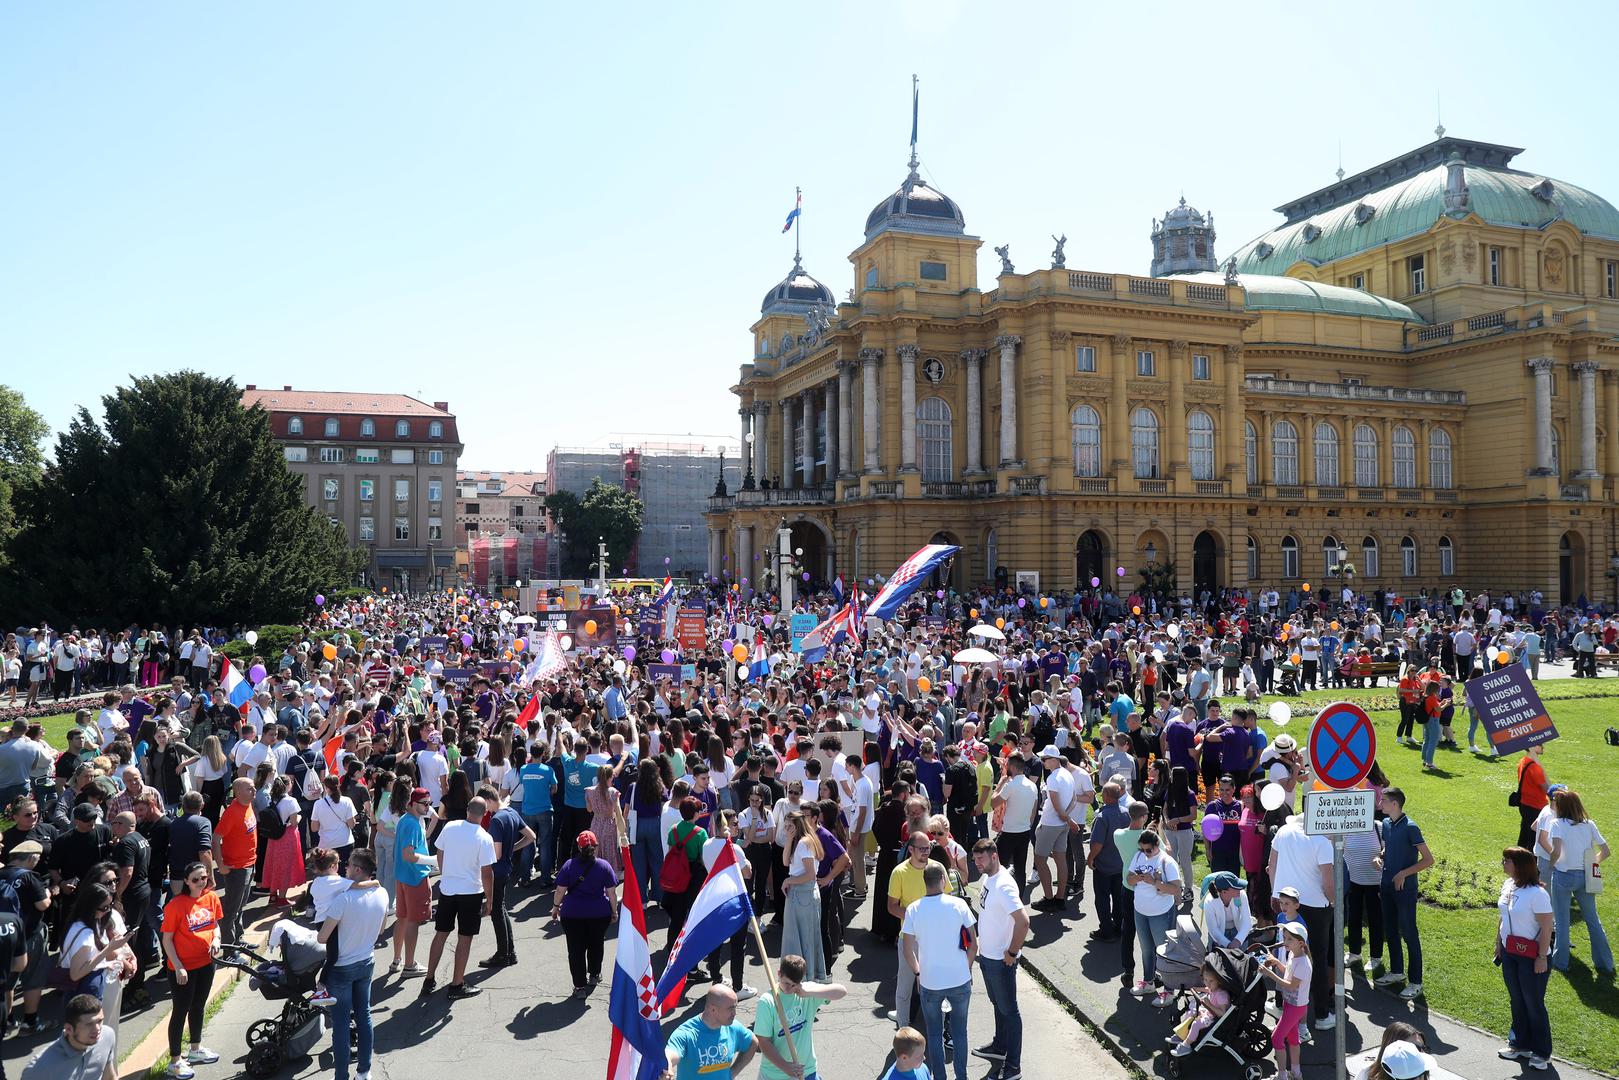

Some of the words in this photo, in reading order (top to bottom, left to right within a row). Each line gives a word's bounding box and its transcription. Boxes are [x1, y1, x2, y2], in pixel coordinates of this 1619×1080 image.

[1482, 674, 1511, 691] SVAKO
[1484, 684, 1522, 704] LJUDSKO
[1490, 702, 1511, 716] BIĆE
[1510, 697, 1529, 710] IMA
[1494, 713, 1523, 729] PRAVO
[1523, 708, 1537, 719] NA
[1507, 723, 1534, 738] ŽIVOT
[1318, 796, 1331, 807] Sva
[1333, 796, 1352, 806] vozila
[1354, 795, 1365, 806] biti
[1316, 808, 1325, 817] će
[1327, 806, 1359, 819] uklonjena
[1361, 808, 1366, 816] o
[1315, 819, 1337, 830] trošku
[1340, 819, 1366, 830] vlasnika
[698, 1042, 728, 1063] HOD
